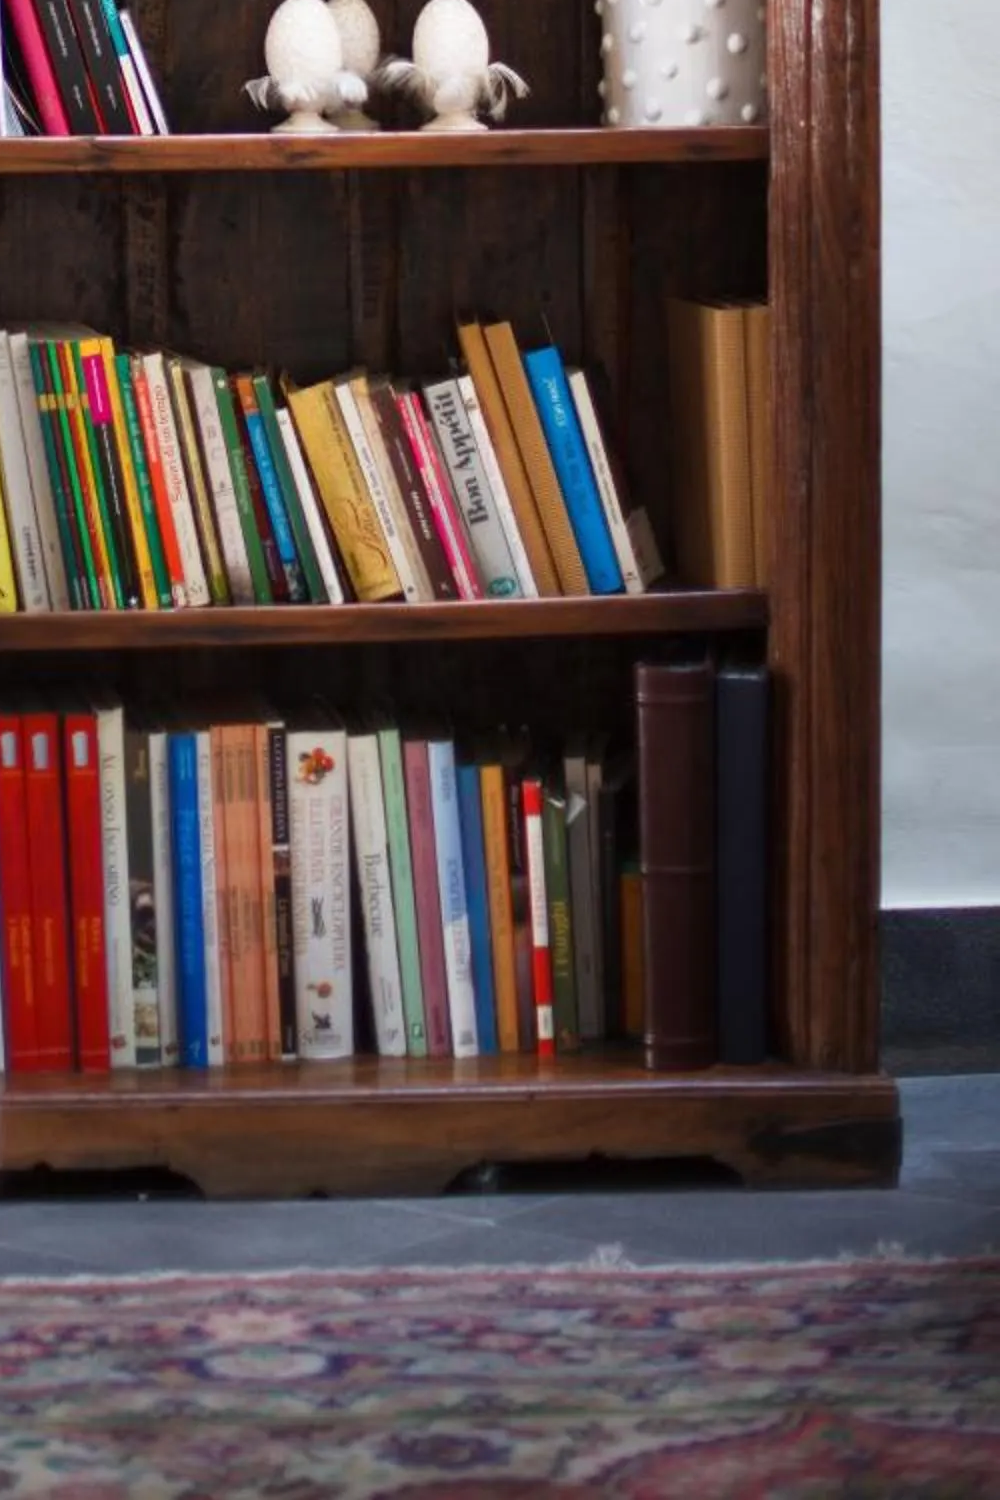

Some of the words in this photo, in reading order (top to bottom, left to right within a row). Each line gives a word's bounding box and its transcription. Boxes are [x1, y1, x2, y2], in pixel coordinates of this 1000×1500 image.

[152, 383, 169, 425] tempo
[433, 391, 479, 473] Appétit
[165, 458, 183, 503] Sapori
[460, 476, 490, 525] Bon
[364, 853, 385, 938] Barbecue
